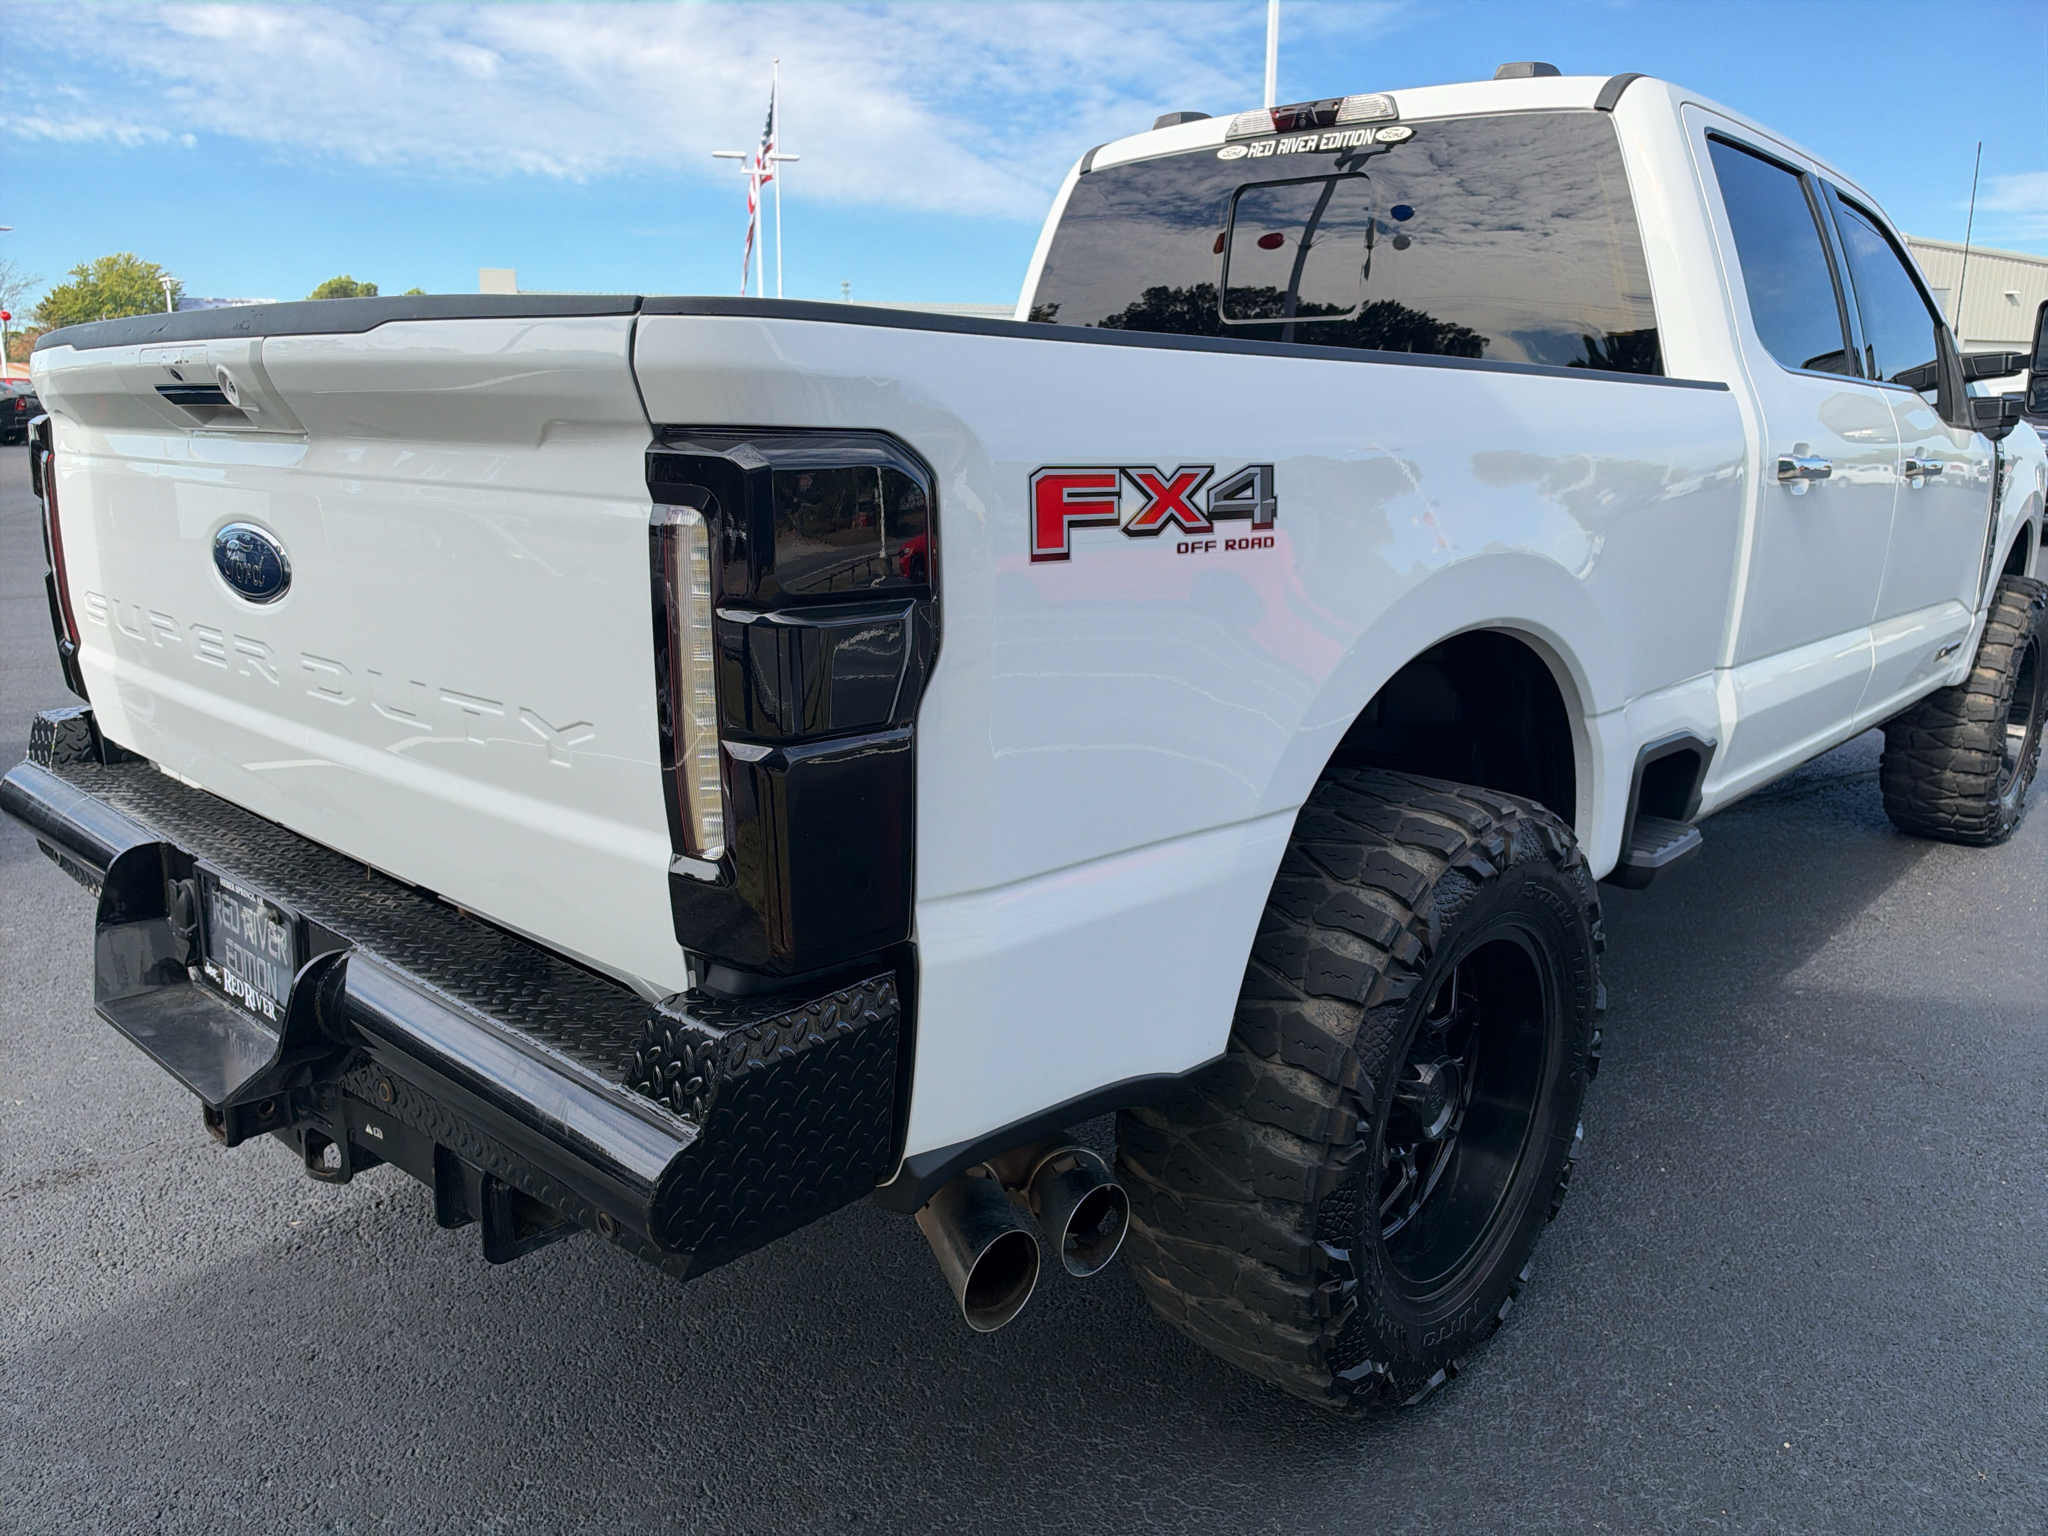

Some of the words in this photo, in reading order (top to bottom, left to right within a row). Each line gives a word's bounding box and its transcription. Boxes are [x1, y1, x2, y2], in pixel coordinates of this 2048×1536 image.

[1248, 140, 1275, 158] RED
[1277, 135, 1318, 155] RIVER
[1319, 128, 1377, 149] EDITION
[1029, 463, 1277, 564] FX4
[1176, 540, 1217, 554] OFF
[1224, 536, 1275, 552] ROAD
[224, 539, 266, 587] Ford
[85, 590, 280, 686] SUPER
[300, 651, 595, 769] DUTY
[211, 889, 240, 935] RED
[241, 905, 288, 966] RIVER
[225, 938, 278, 1002] EDITION
